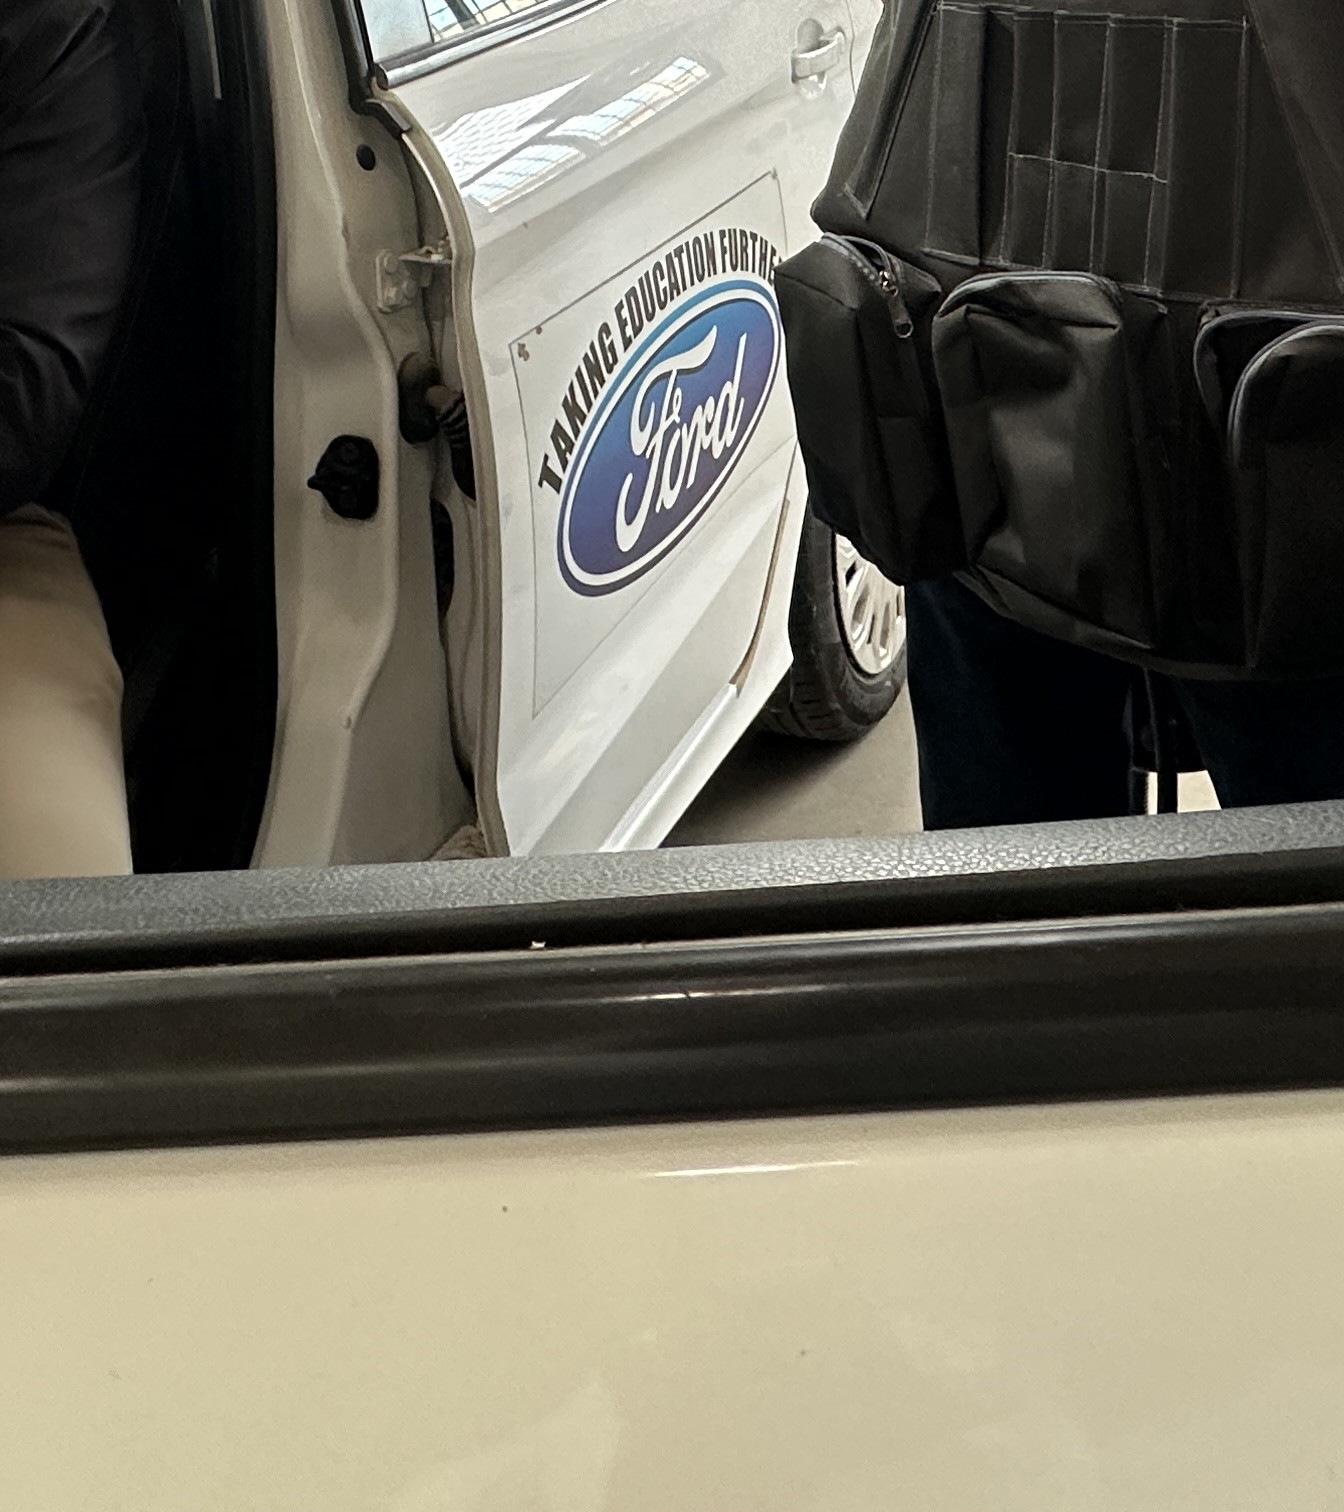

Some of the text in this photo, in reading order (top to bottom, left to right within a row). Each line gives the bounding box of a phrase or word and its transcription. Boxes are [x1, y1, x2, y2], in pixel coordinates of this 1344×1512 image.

[538, 228, 782, 495] TAKING EDUCATION FURTHE
[616, 325, 748, 553] Ford
